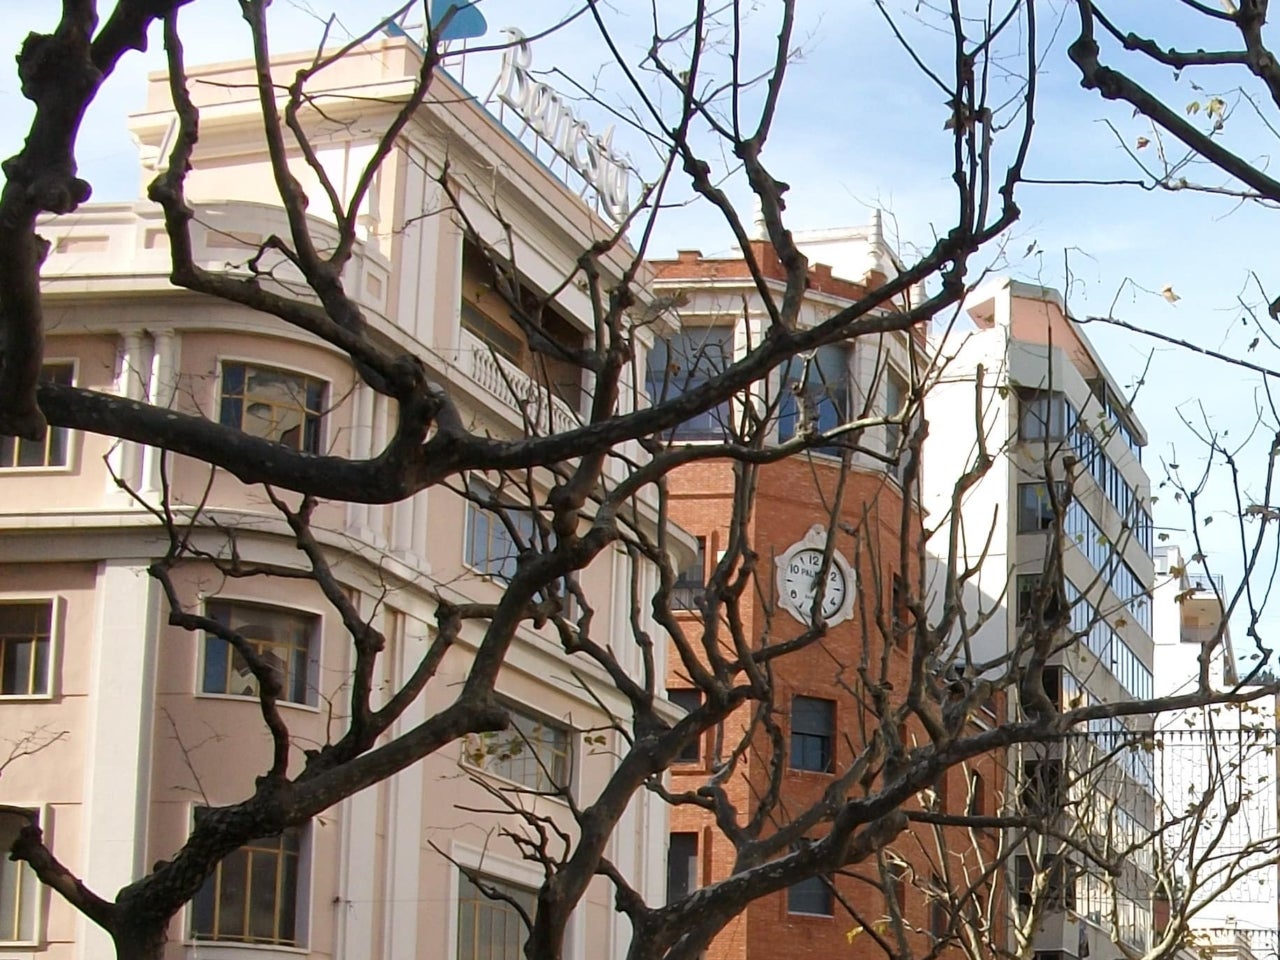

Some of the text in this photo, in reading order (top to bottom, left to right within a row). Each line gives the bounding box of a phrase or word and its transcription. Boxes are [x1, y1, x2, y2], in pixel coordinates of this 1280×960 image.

[808, 554, 820, 566] 12
[790, 563, 800, 575] 10
[830, 572, 837, 582] 2
